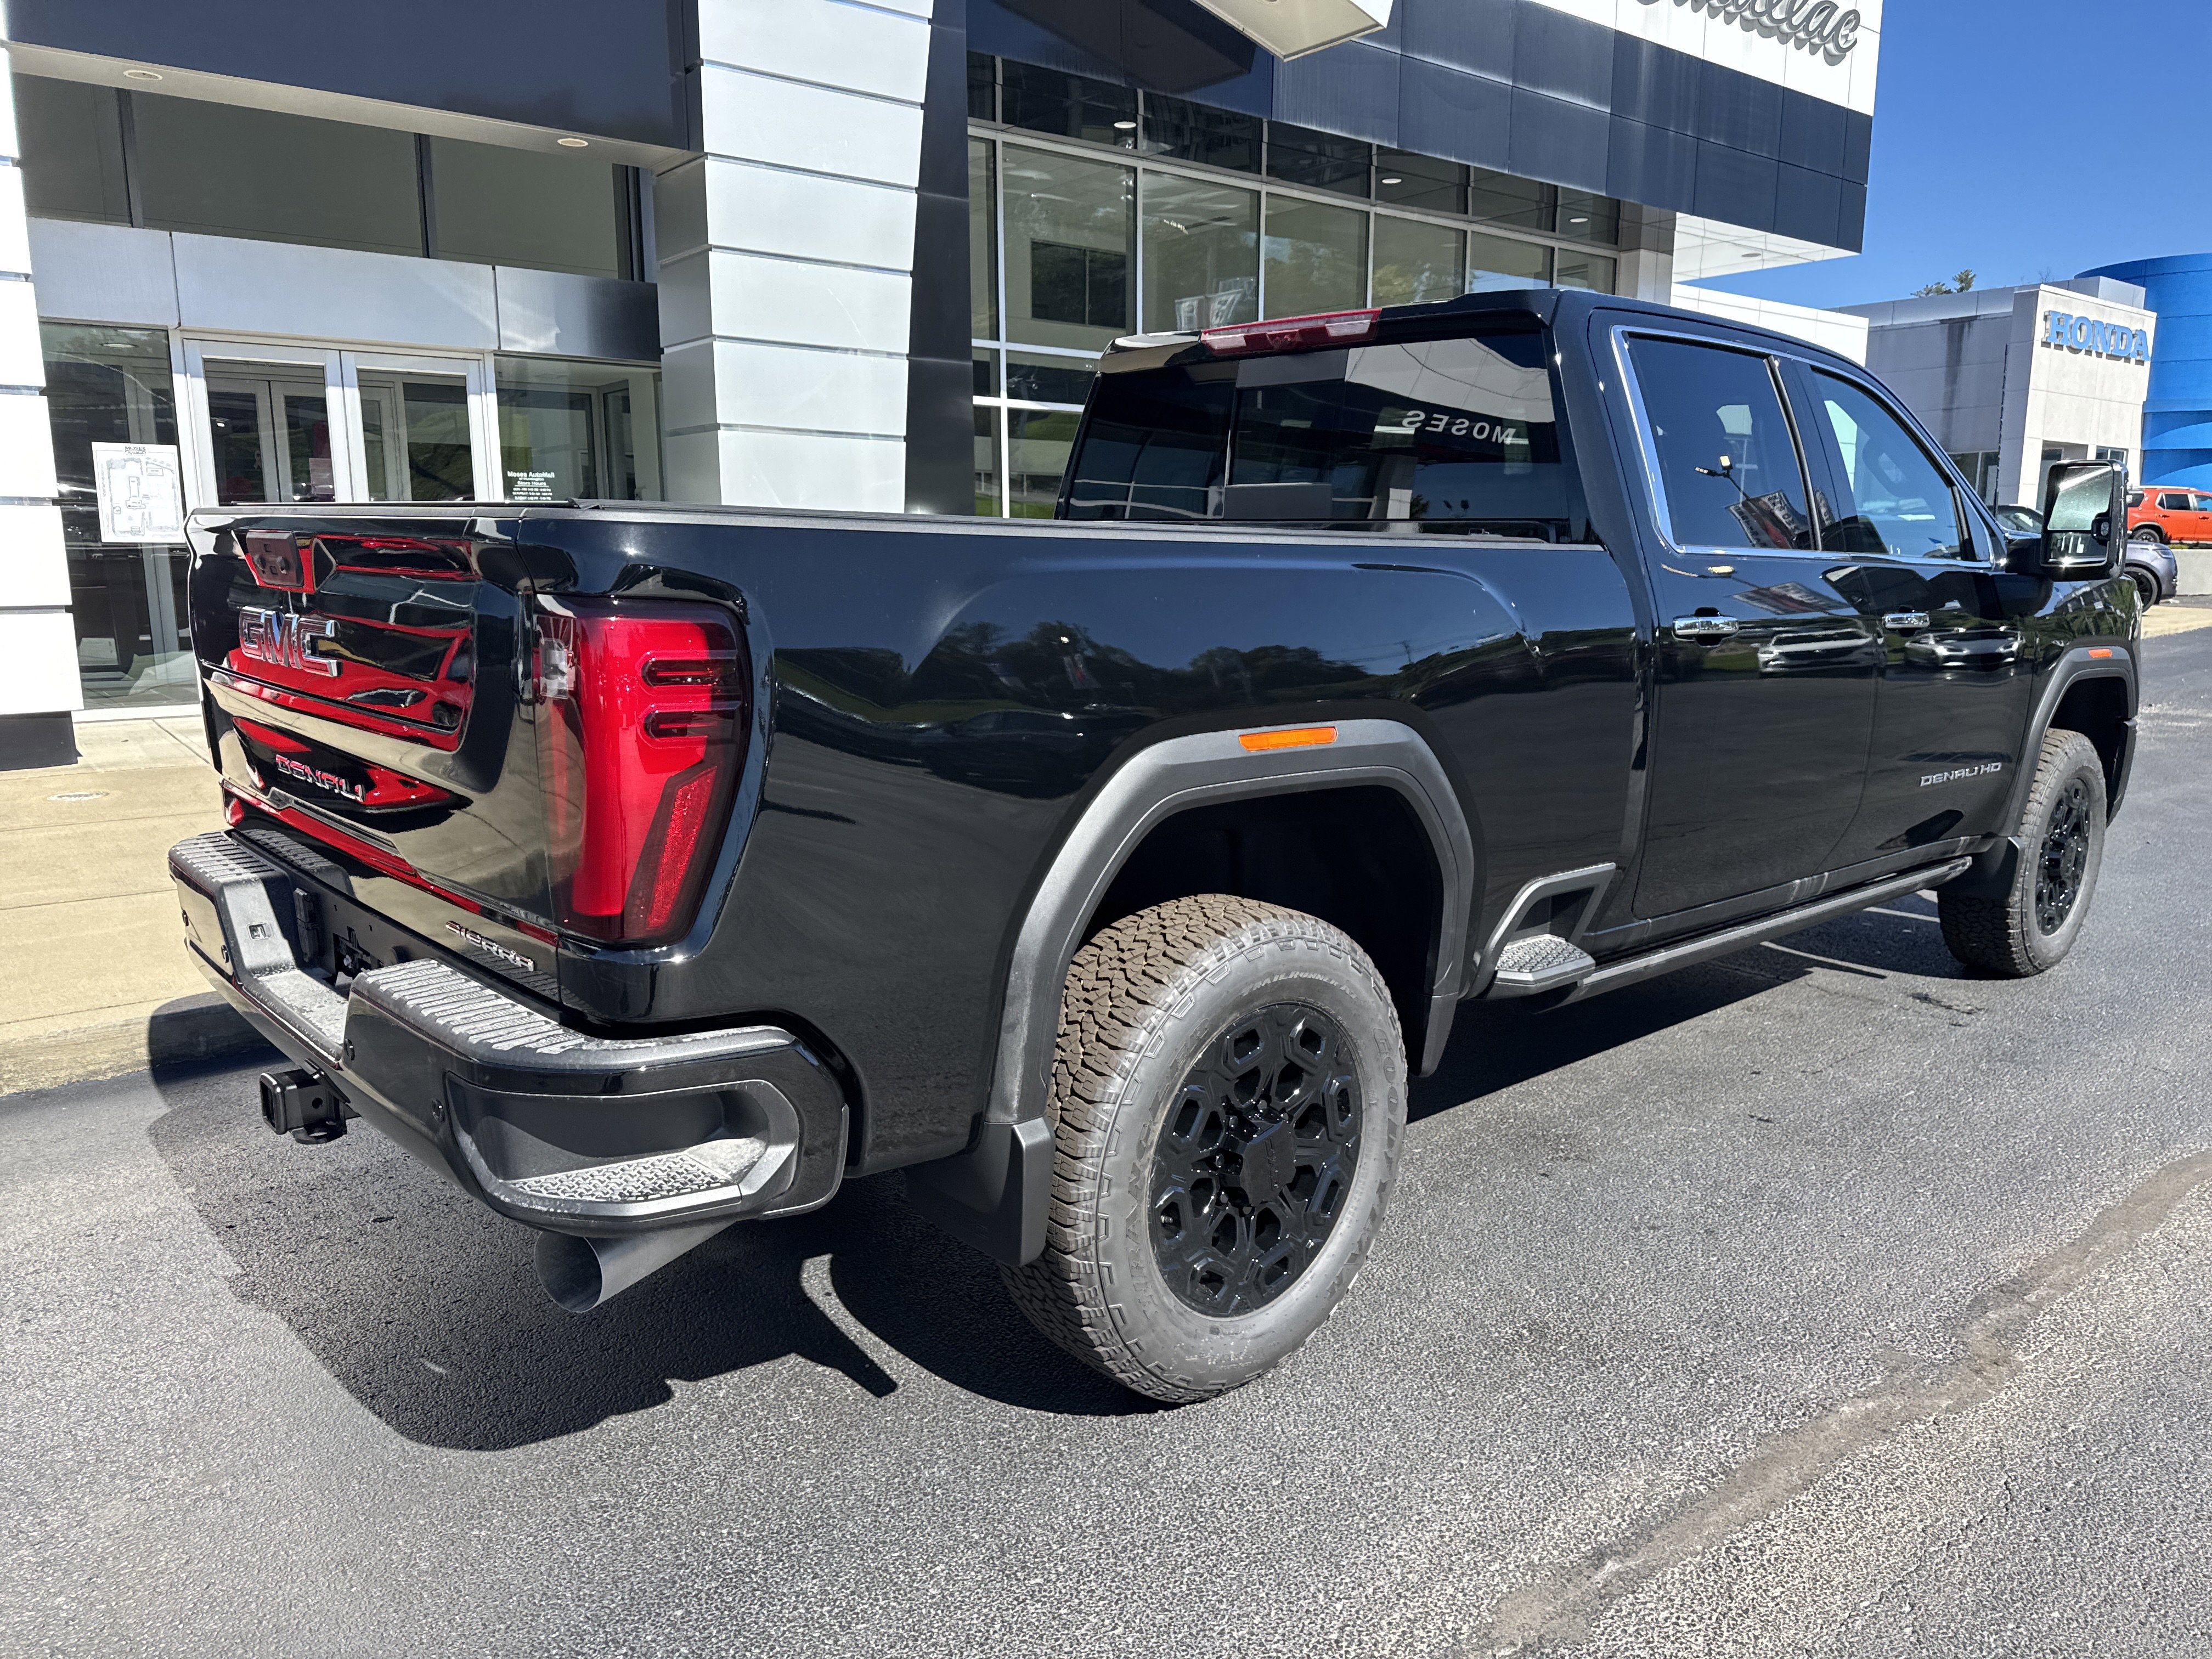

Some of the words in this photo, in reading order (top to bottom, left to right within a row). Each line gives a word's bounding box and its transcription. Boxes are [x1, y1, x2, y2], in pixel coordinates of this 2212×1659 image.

[2045, 310, 2151, 362] HONDA
[239, 606, 342, 678] GMC
[275, 754, 365, 803] DENALI
[1920, 766, 1978, 787] DENALI
[1979, 761, 2002, 775] HD
